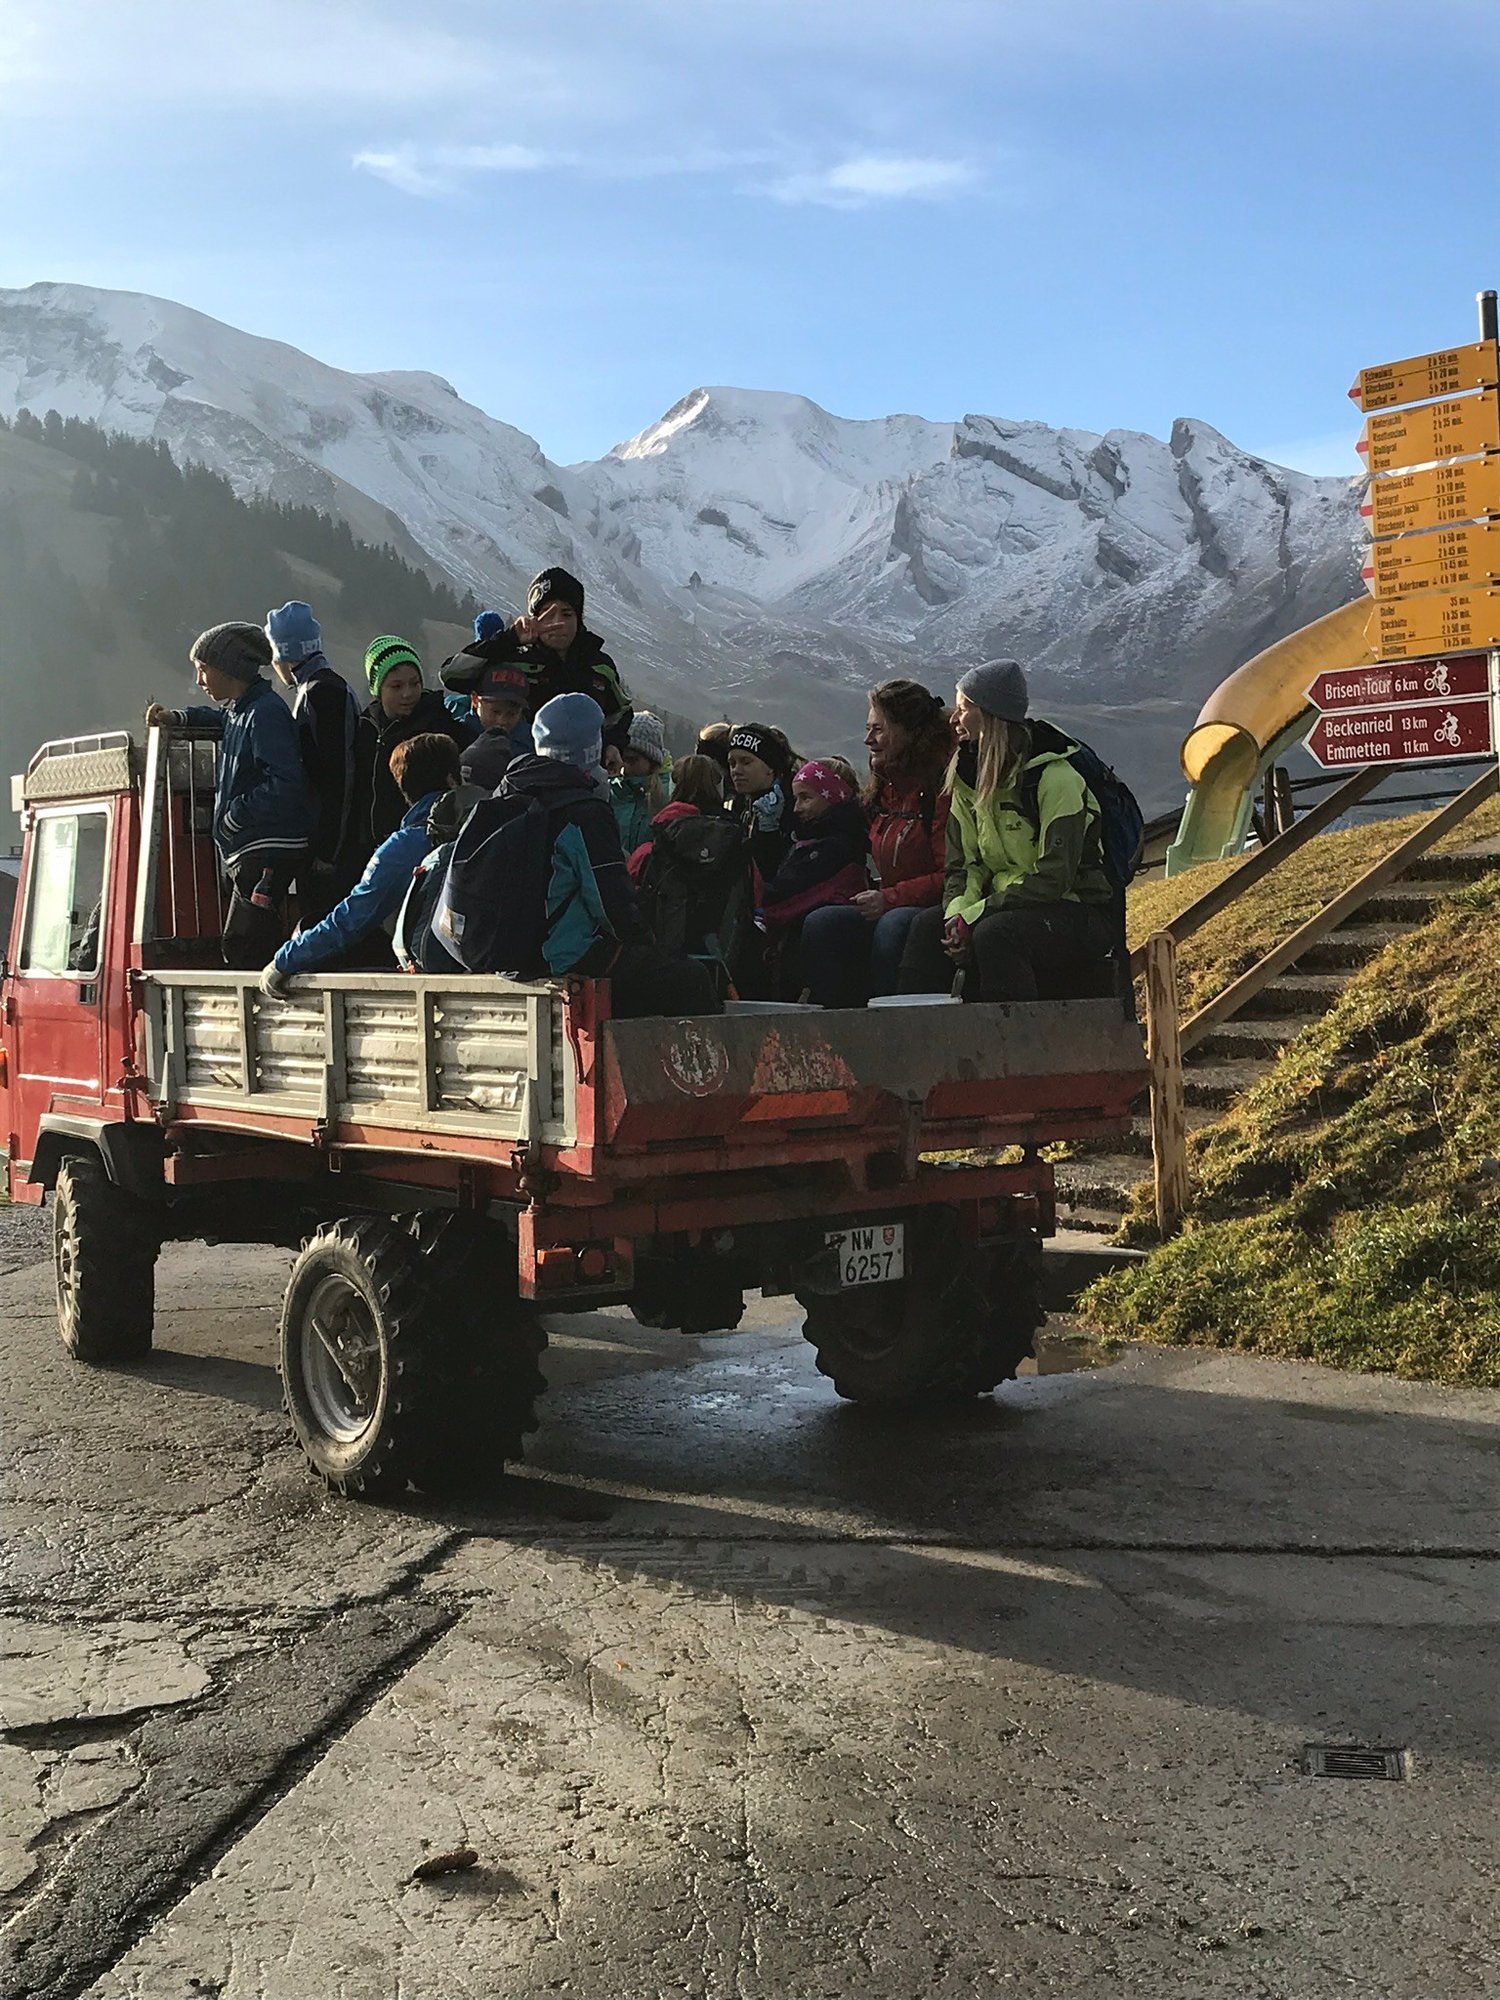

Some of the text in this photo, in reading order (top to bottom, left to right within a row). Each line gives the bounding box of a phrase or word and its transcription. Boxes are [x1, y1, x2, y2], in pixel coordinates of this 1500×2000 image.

[1443, 417, 1450, 428] 35
[1403, 476, 1414, 488] SAC
[1448, 546, 1455, 555] 45
[1449, 560, 1456, 569] 45
[1450, 596, 1458, 607] 35
[1451, 610, 1458, 620] 35
[1452, 623, 1459, 633] 50
[1452, 637, 1460, 647] 25
[1461, 637, 1472, 645] min.
[1325, 678, 1418, 700] Brisen-Tour 6 km
[1325, 714, 1428, 738] Beckenried 13 km
[730, 733, 761, 752] SCBK
[1327, 740, 1429, 761] Emmetten 11 km
[852, 1229, 873, 1251] NW
[846, 1251, 893, 1283] 6257
